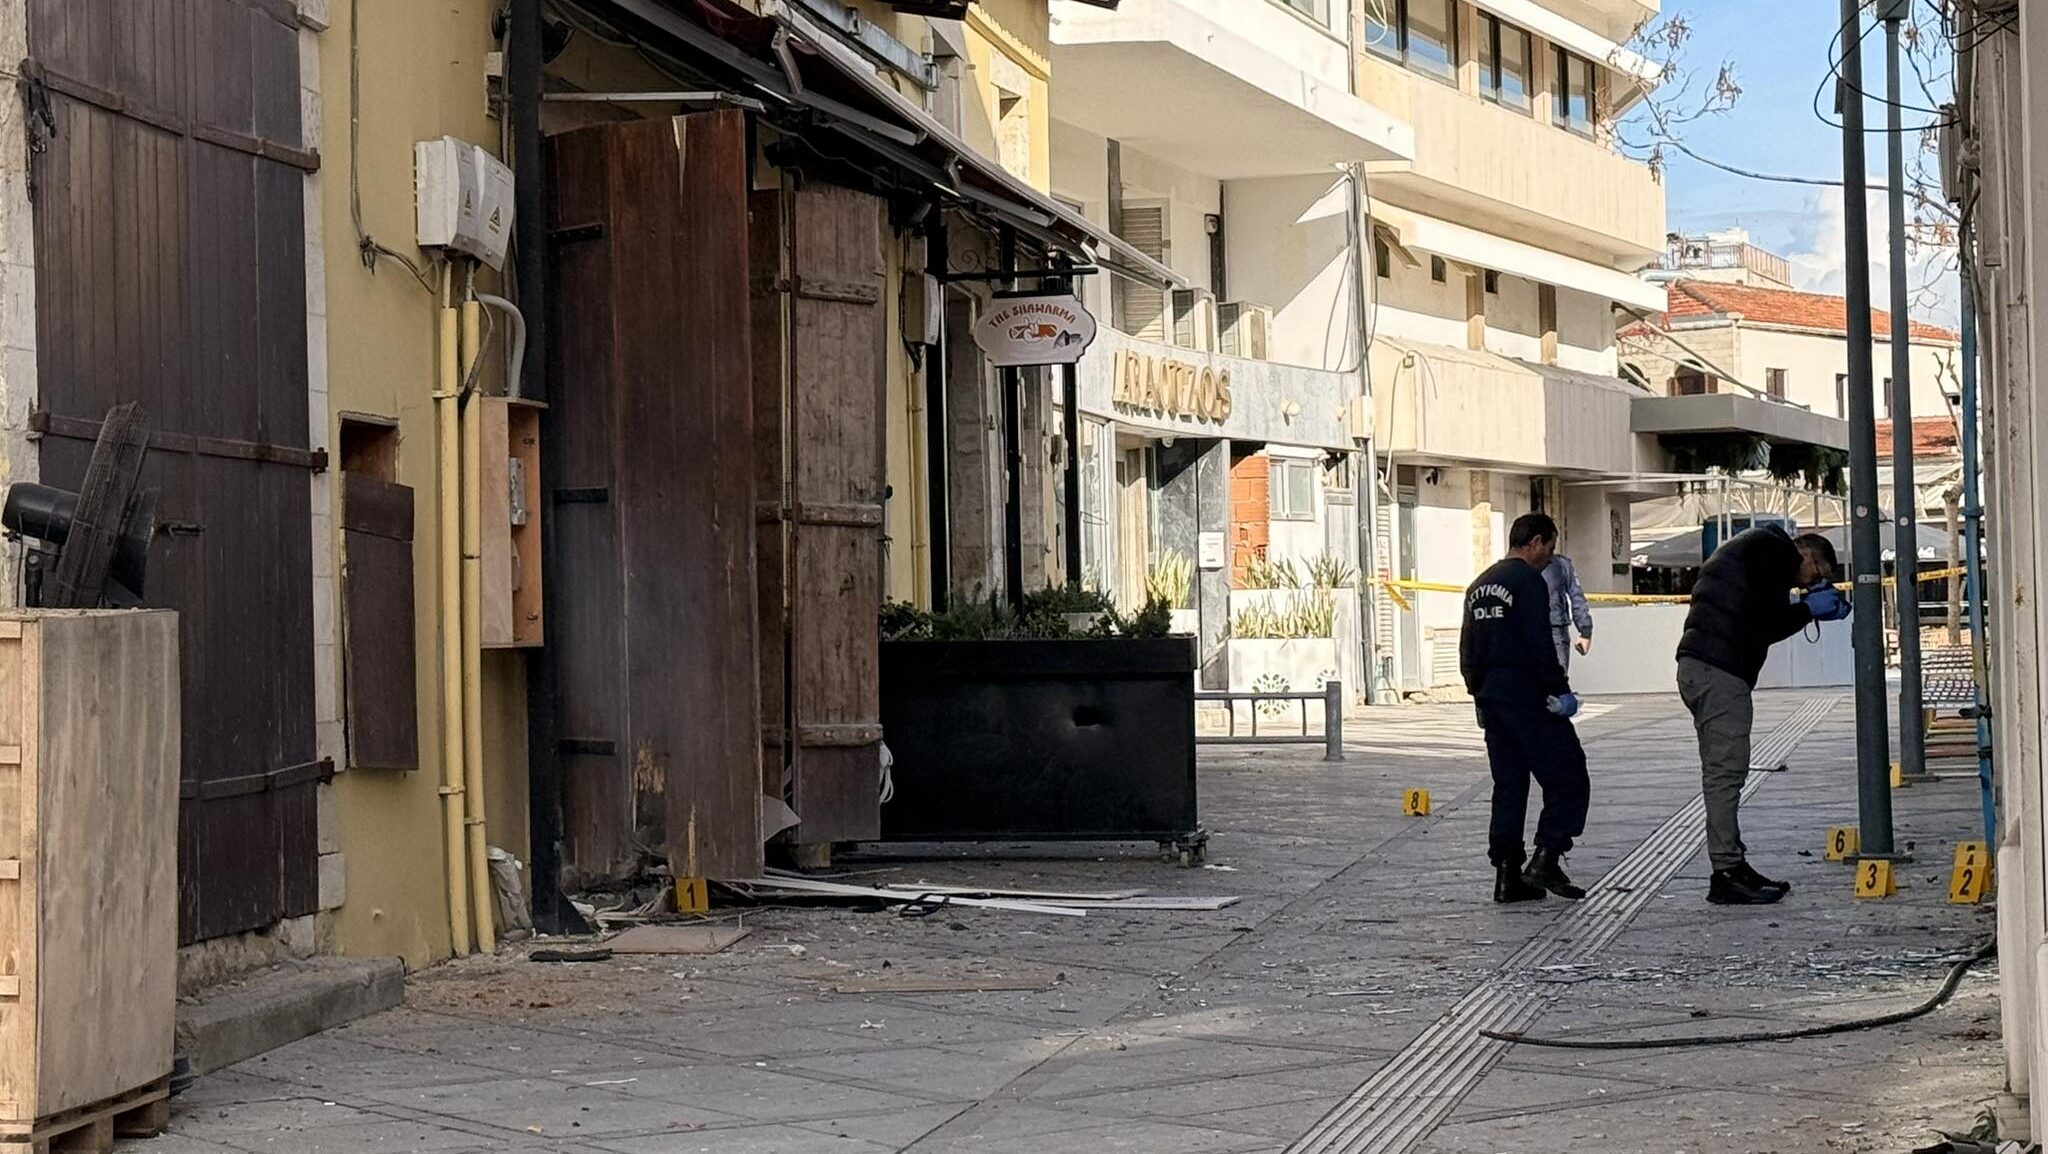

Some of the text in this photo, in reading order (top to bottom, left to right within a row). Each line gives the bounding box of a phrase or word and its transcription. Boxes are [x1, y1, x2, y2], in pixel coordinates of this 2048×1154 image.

[988, 303, 1077, 329] THE SHAWARMA
[1411, 791, 1420, 811] 8
[1835, 829, 1846, 854] 6
[1865, 863, 1878, 890] 3
[1959, 868, 1974, 896] 2
[686, 882, 696, 909] 1
